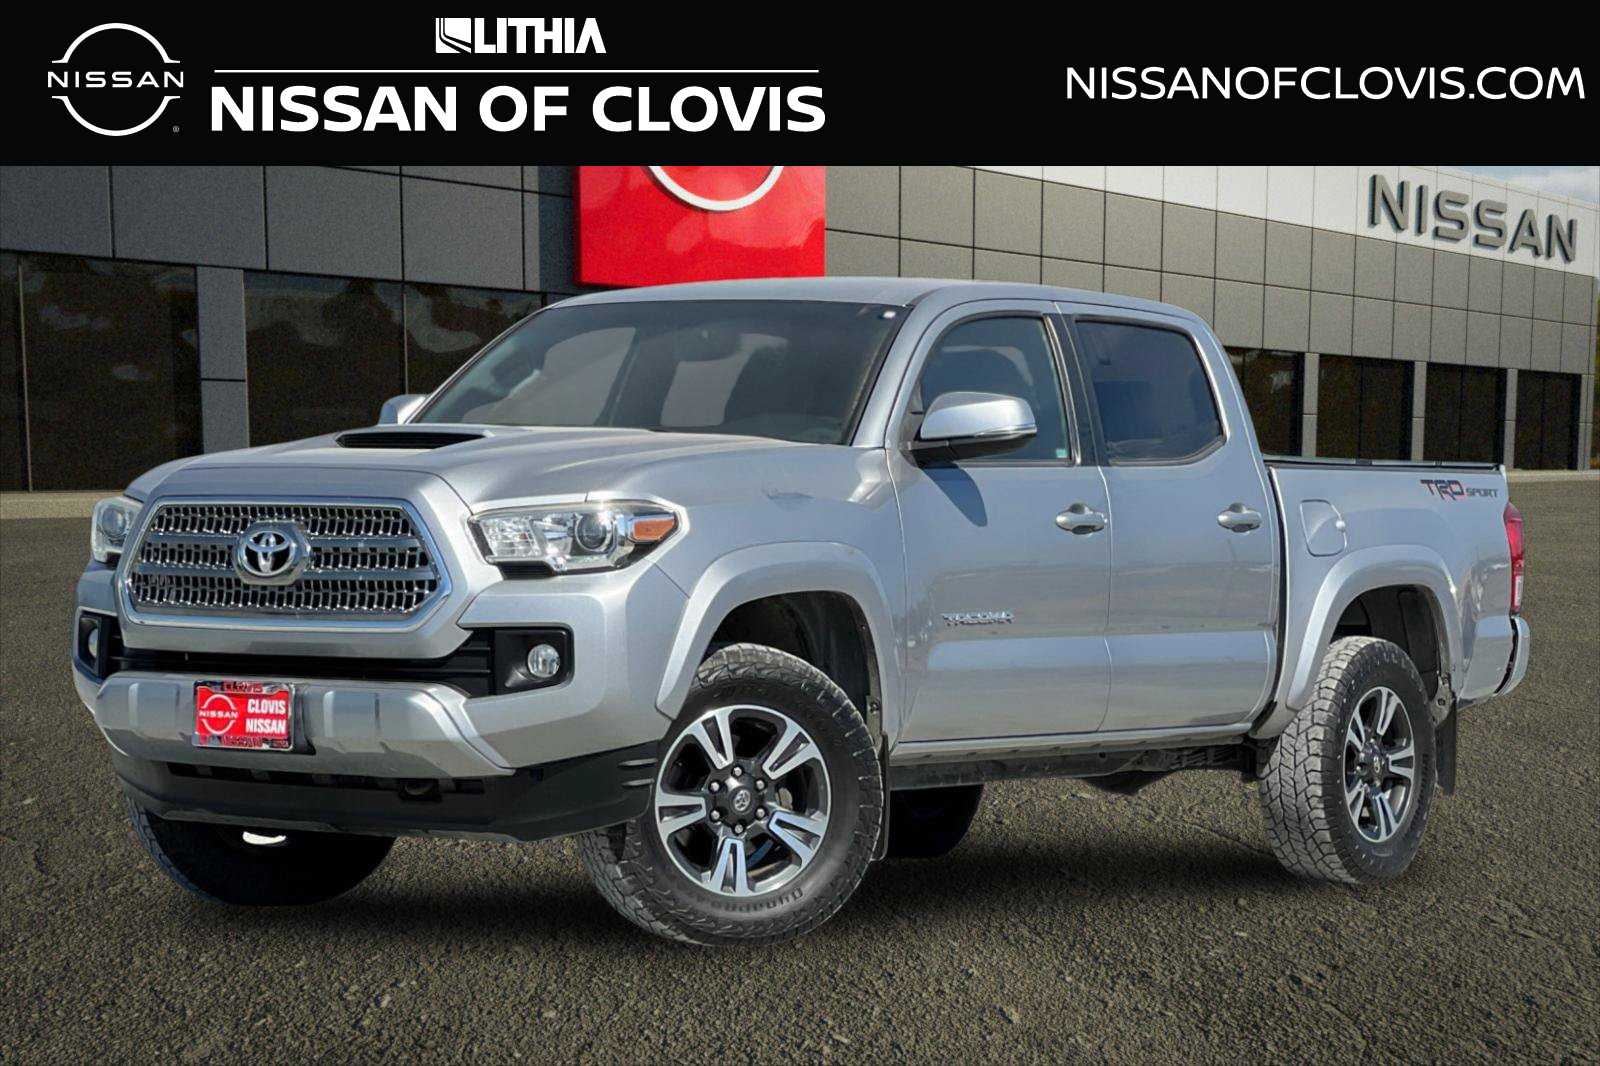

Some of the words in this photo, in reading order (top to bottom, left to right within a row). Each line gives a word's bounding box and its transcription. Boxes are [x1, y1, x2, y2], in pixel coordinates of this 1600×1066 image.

[1367, 173, 1578, 264] NISSAN
[1420, 479, 1465, 500] TRD
[1465, 487, 1499, 498] SPORT
[198, 710, 239, 718] NISSAN
[247, 698, 286, 715] CLOVIS
[245, 718, 286, 734] NISSAN
